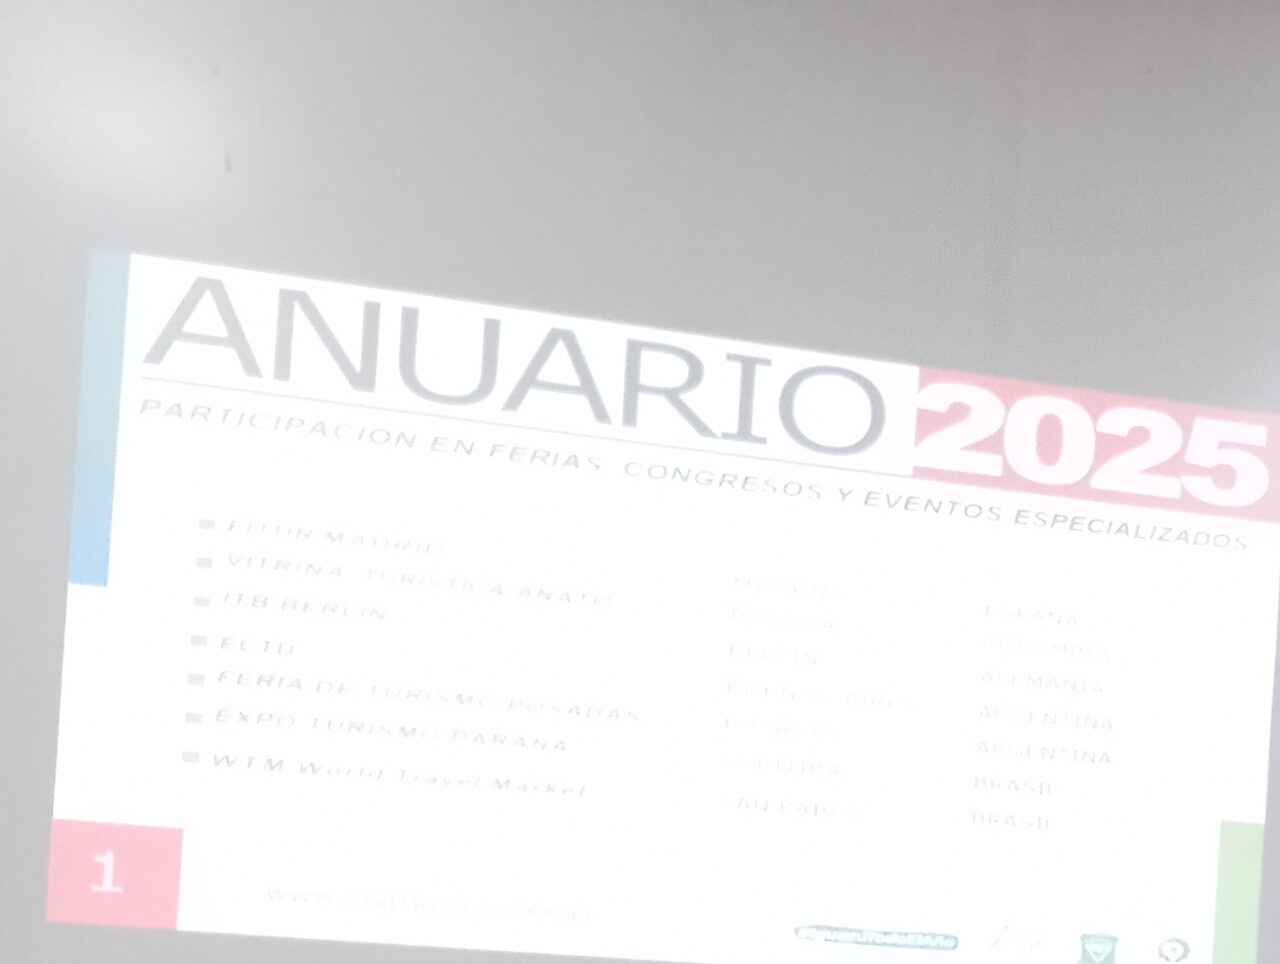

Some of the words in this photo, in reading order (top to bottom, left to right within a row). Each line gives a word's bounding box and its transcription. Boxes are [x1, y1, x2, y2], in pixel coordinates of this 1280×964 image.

[142, 275, 888, 457] ANUARIO
[139, 398, 418, 450] PARTICIPACION
[430, 434, 475, 457] EN
[488, 442, 602, 473] FERIAS
[623, 460, 823, 501] CONGRESOS
[837, 486, 854, 503] Y
[863, 490, 1003, 522] EVENTOS
[1013, 508, 1249, 552] ESPECIALIZADOS
[912, 382, 1270, 508] 2025
[91, 851, 123, 892] 1
